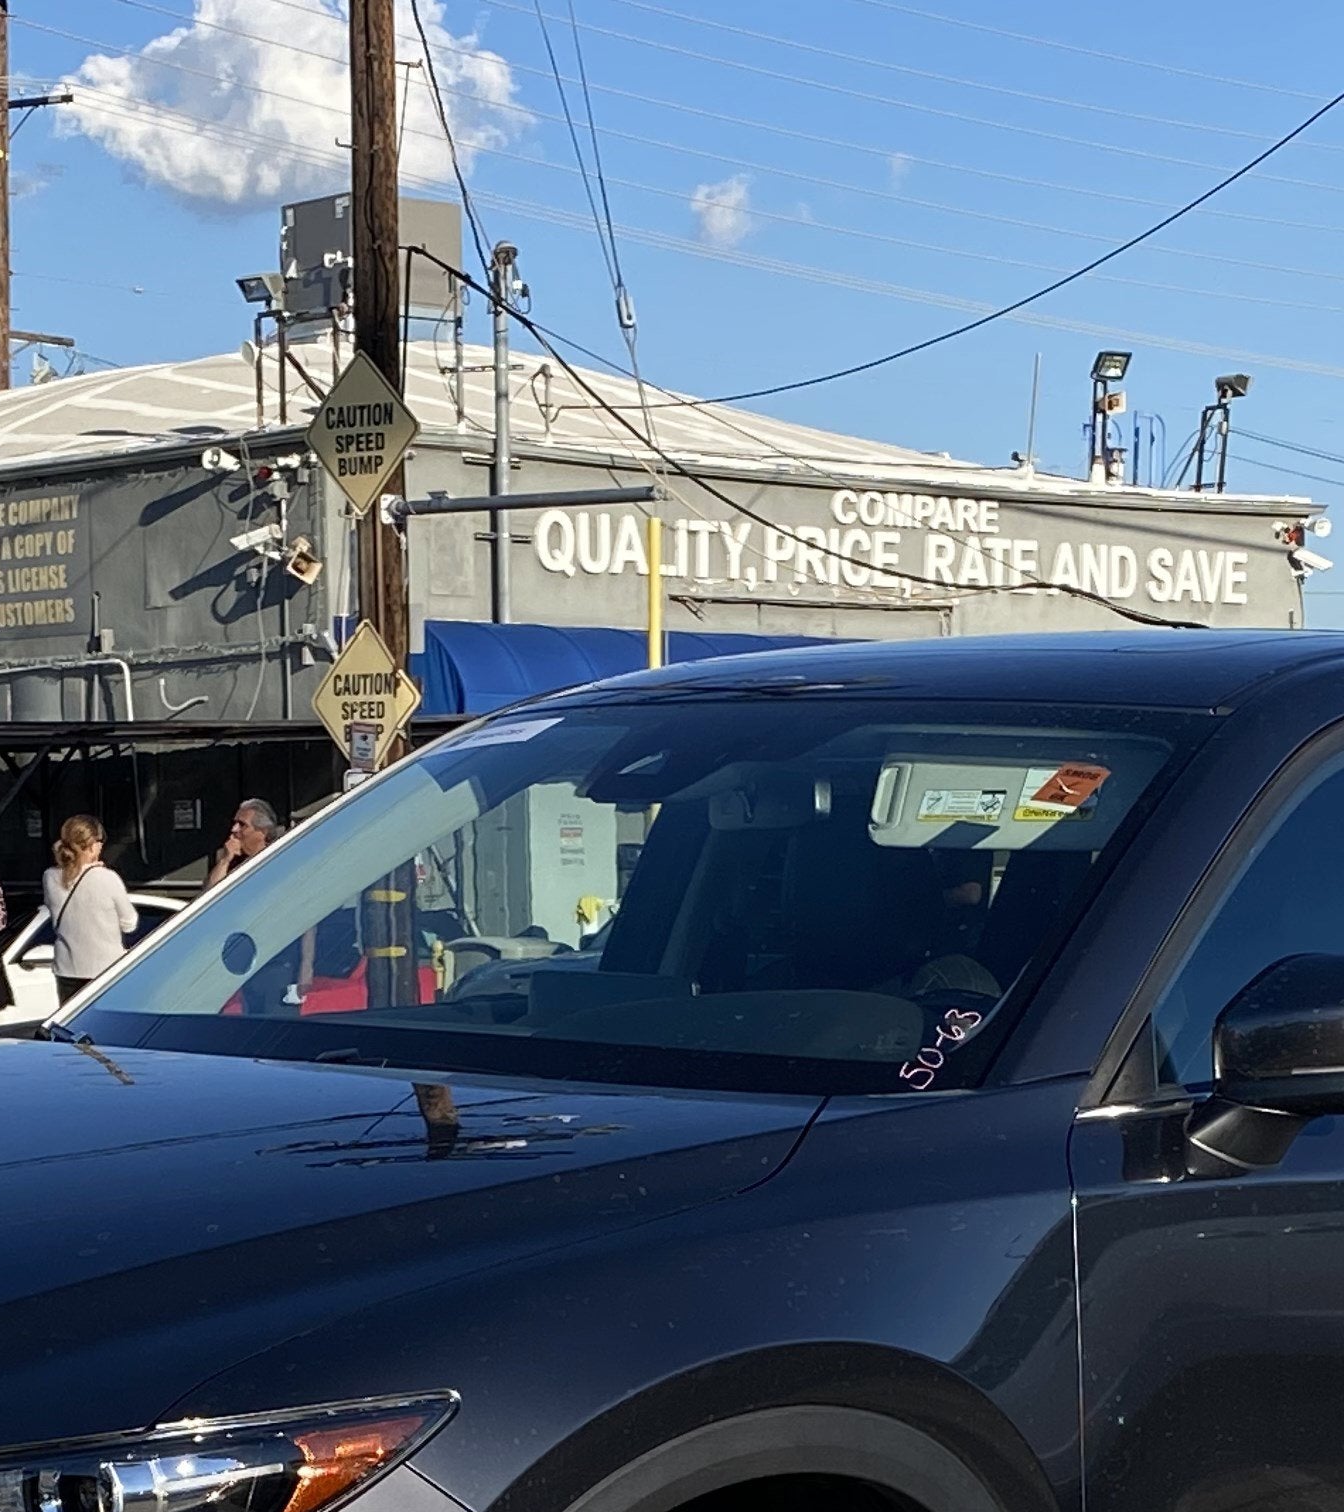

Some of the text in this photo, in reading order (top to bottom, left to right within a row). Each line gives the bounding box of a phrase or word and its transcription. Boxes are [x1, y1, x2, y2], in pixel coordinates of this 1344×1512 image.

[325, 402, 394, 430] CAUTION
[335, 432, 385, 454] SPEED
[338, 455, 384, 477] BUMP
[8, 495, 80, 526] COMPANY
[831, 489, 1000, 533] COMPARE
[1, 536, 12, 560] A
[14, 531, 54, 559] COPY
[56, 529, 76, 555] OF
[8, 564, 67, 593] LICENSE
[764, 525, 913, 599] PRICE,
[924, 532, 1039, 595] RATE
[1048, 542, 1137, 600] AND
[1145, 547, 1248, 604] SAVE
[333, 673, 394, 697] CAUTION
[341, 701, 386, 721] SPEED
